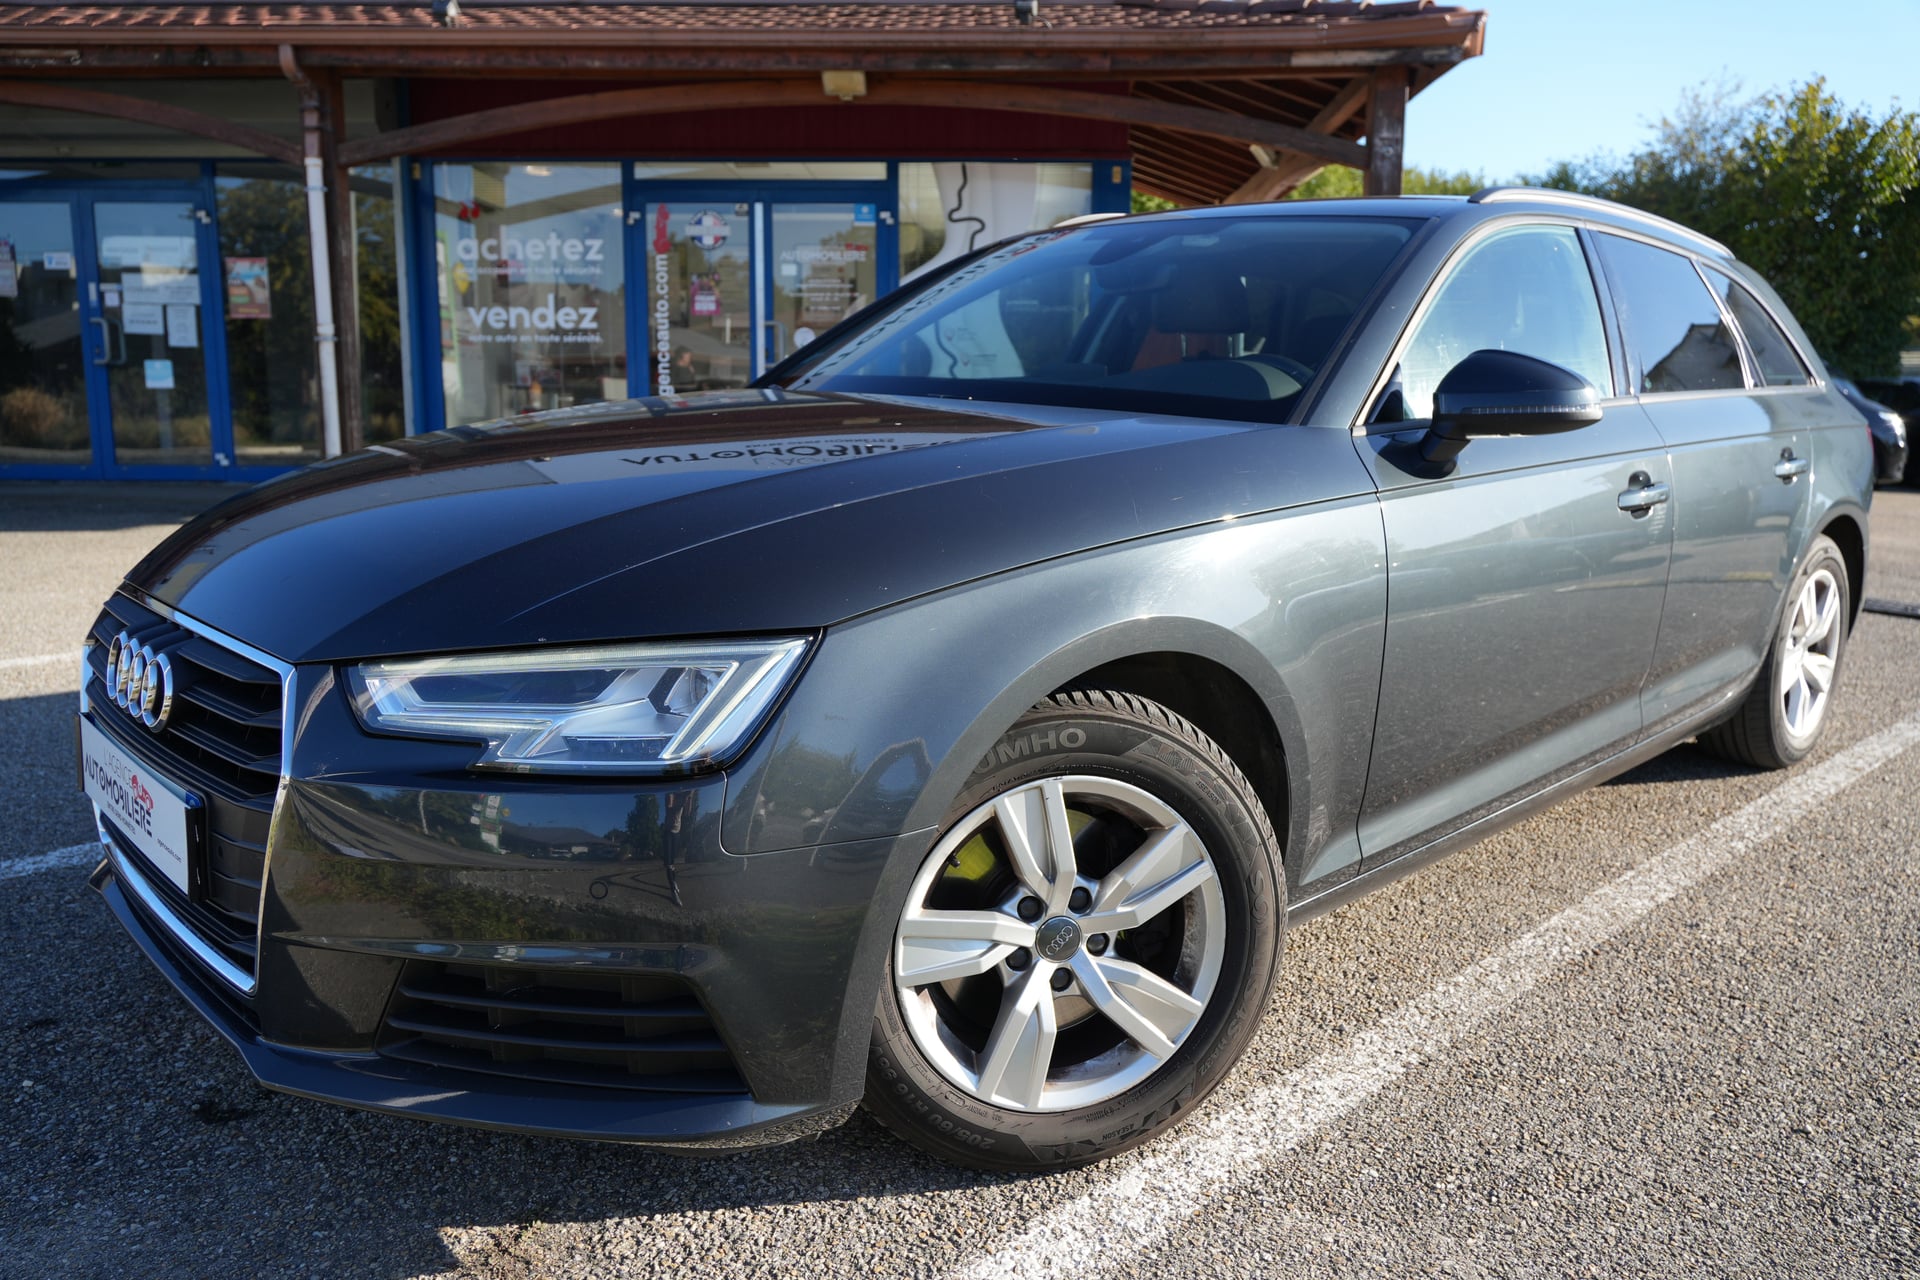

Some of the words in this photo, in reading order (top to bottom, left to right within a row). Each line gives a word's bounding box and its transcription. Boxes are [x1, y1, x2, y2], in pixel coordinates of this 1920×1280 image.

[456, 226, 604, 261] achetez
[468, 293, 598, 329] vendez
[655, 254, 675, 397] genceauto.com
[972, 728, 1087, 774] UMHO
[1102, 1123, 1135, 1141] 4SEASON
